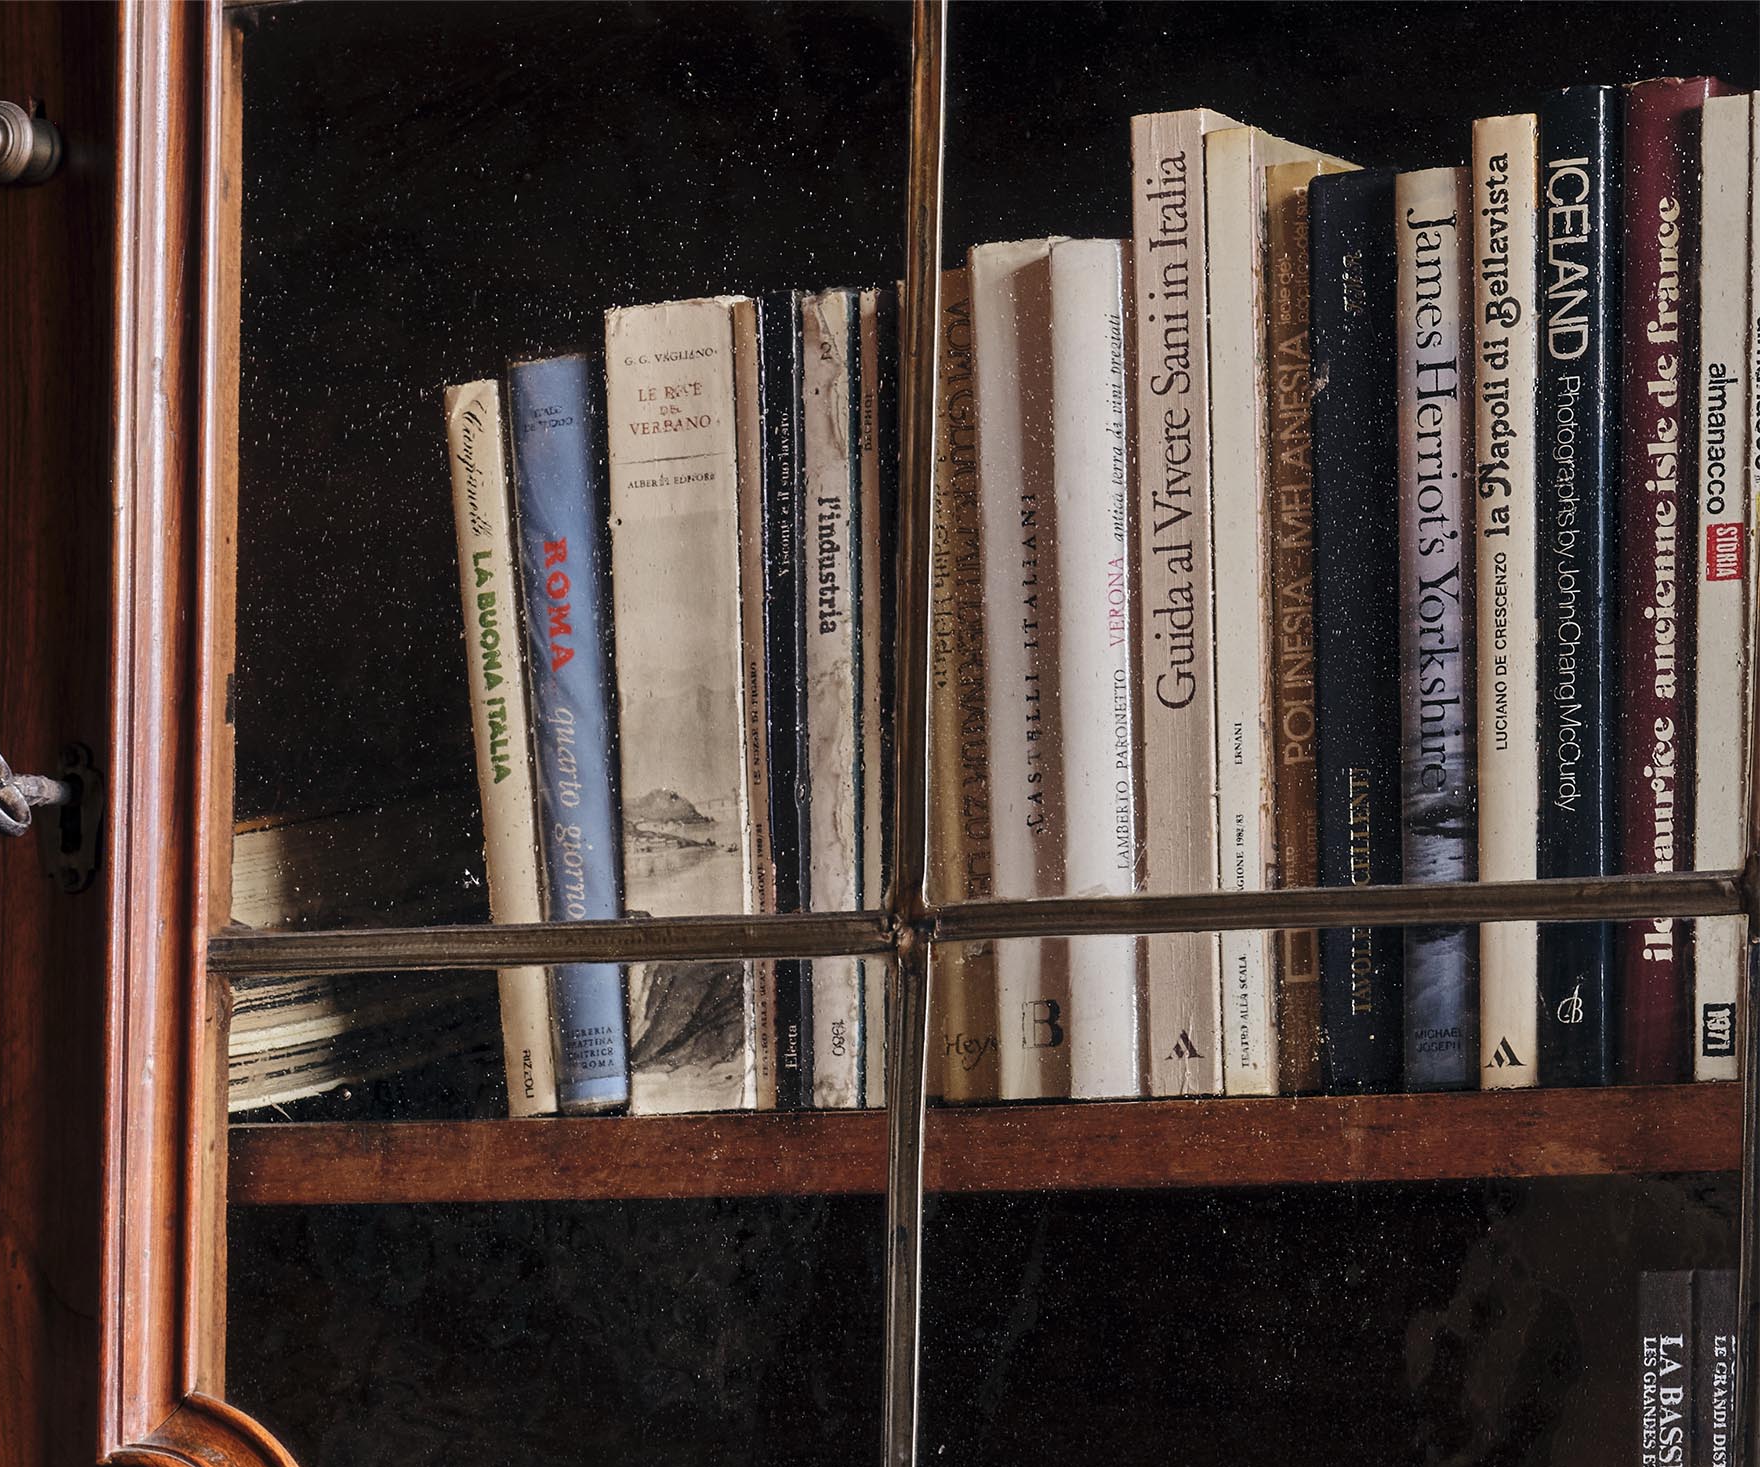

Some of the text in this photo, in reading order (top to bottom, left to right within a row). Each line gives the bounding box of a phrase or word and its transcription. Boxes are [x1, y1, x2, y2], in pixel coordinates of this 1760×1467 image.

[1546, 156, 1591, 361] ICELAND
[1645, 194, 1681, 343] france
[1479, 151, 1523, 539] la Napoli di Bellavista
[1646, 354, 1679, 408] de
[1145, 150, 1197, 711] Guida al Vivere Sani in Italia
[1405, 207, 1466, 790] James Herriot's Yorkshire
[1644, 416, 1679, 494] isle
[1705, 363, 1738, 515] almanacco
[817, 495, 843, 636] l'industria
[1276, 329, 1316, 766] POLINESIA MELANESIA
[1552, 374, 1583, 812] Photographs by John Chang McCurdy
[1643, 500, 1678, 699] ancienne
[1715, 525, 1739, 578] STORIA
[471, 550, 512, 785] LA BUONA ITALIA
[1021, 493, 1043, 829] CASTELLI ITALIANI
[1105, 383, 1130, 869] LAMBERTO PARONETTO VERONA antica terra vini
[1492, 551, 1509, 751] LUCIANO DE CRESCENZO
[542, 537, 588, 920] ROMA quarto giorno
[1234, 722, 1244, 765] ERNANI
[1643, 716, 1676, 874] aurice
[783, 1023, 799, 1071] Electa
[1414, 1027, 1462, 1041] MICHAEL
[1415, 1041, 1461, 1053] JOSEPH
[1704, 1007, 1732, 1051] 1971
[1642, 1336, 1658, 1367] LES
[1642, 1371, 1657, 1449] GRANDES
[1659, 1333, 1684, 1377] LA
[1712, 1361, 1728, 1429] GRANDI
[1713, 1334, 1728, 1358] LE
